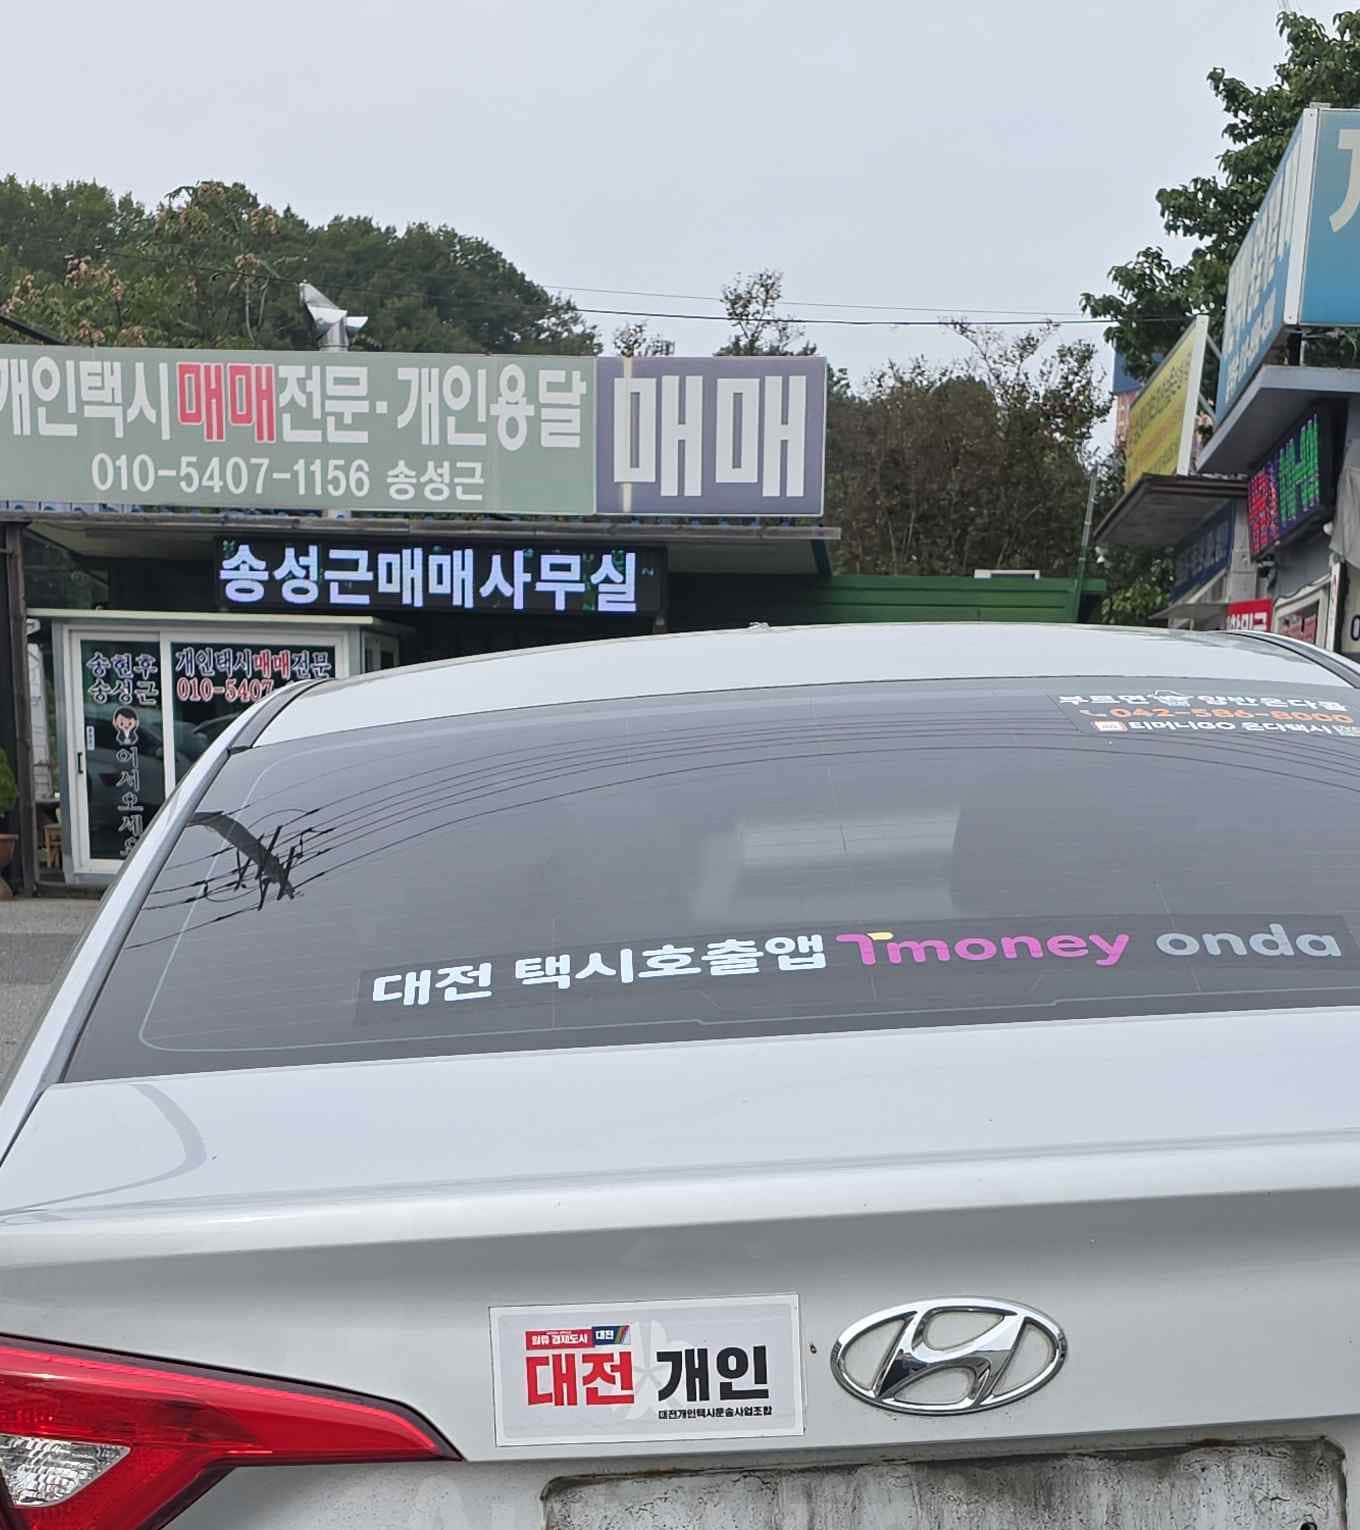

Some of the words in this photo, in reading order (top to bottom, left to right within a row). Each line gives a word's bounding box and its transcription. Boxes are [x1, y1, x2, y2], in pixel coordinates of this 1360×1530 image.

[614, 375, 806, 498] 매매
[90, 452, 371, 498] 010-5407-1156
[386, 460, 486, 502] 송성근
[219, 543, 639, 614] 송성근매매사무실
[1109, 707, 1354, 723] 042-586-8000
[372, 961, 494, 1007] 대전
[513, 933, 827, 991] 택시호출앱
[835, 930, 1131, 966] Tmoney
[1155, 923, 1342, 958] onda
[525, 1351, 635, 1406] 대전
[656, 1345, 770, 1402] 개인
[658, 1405, 773, 1420] 대전개인택시운송사업조합
